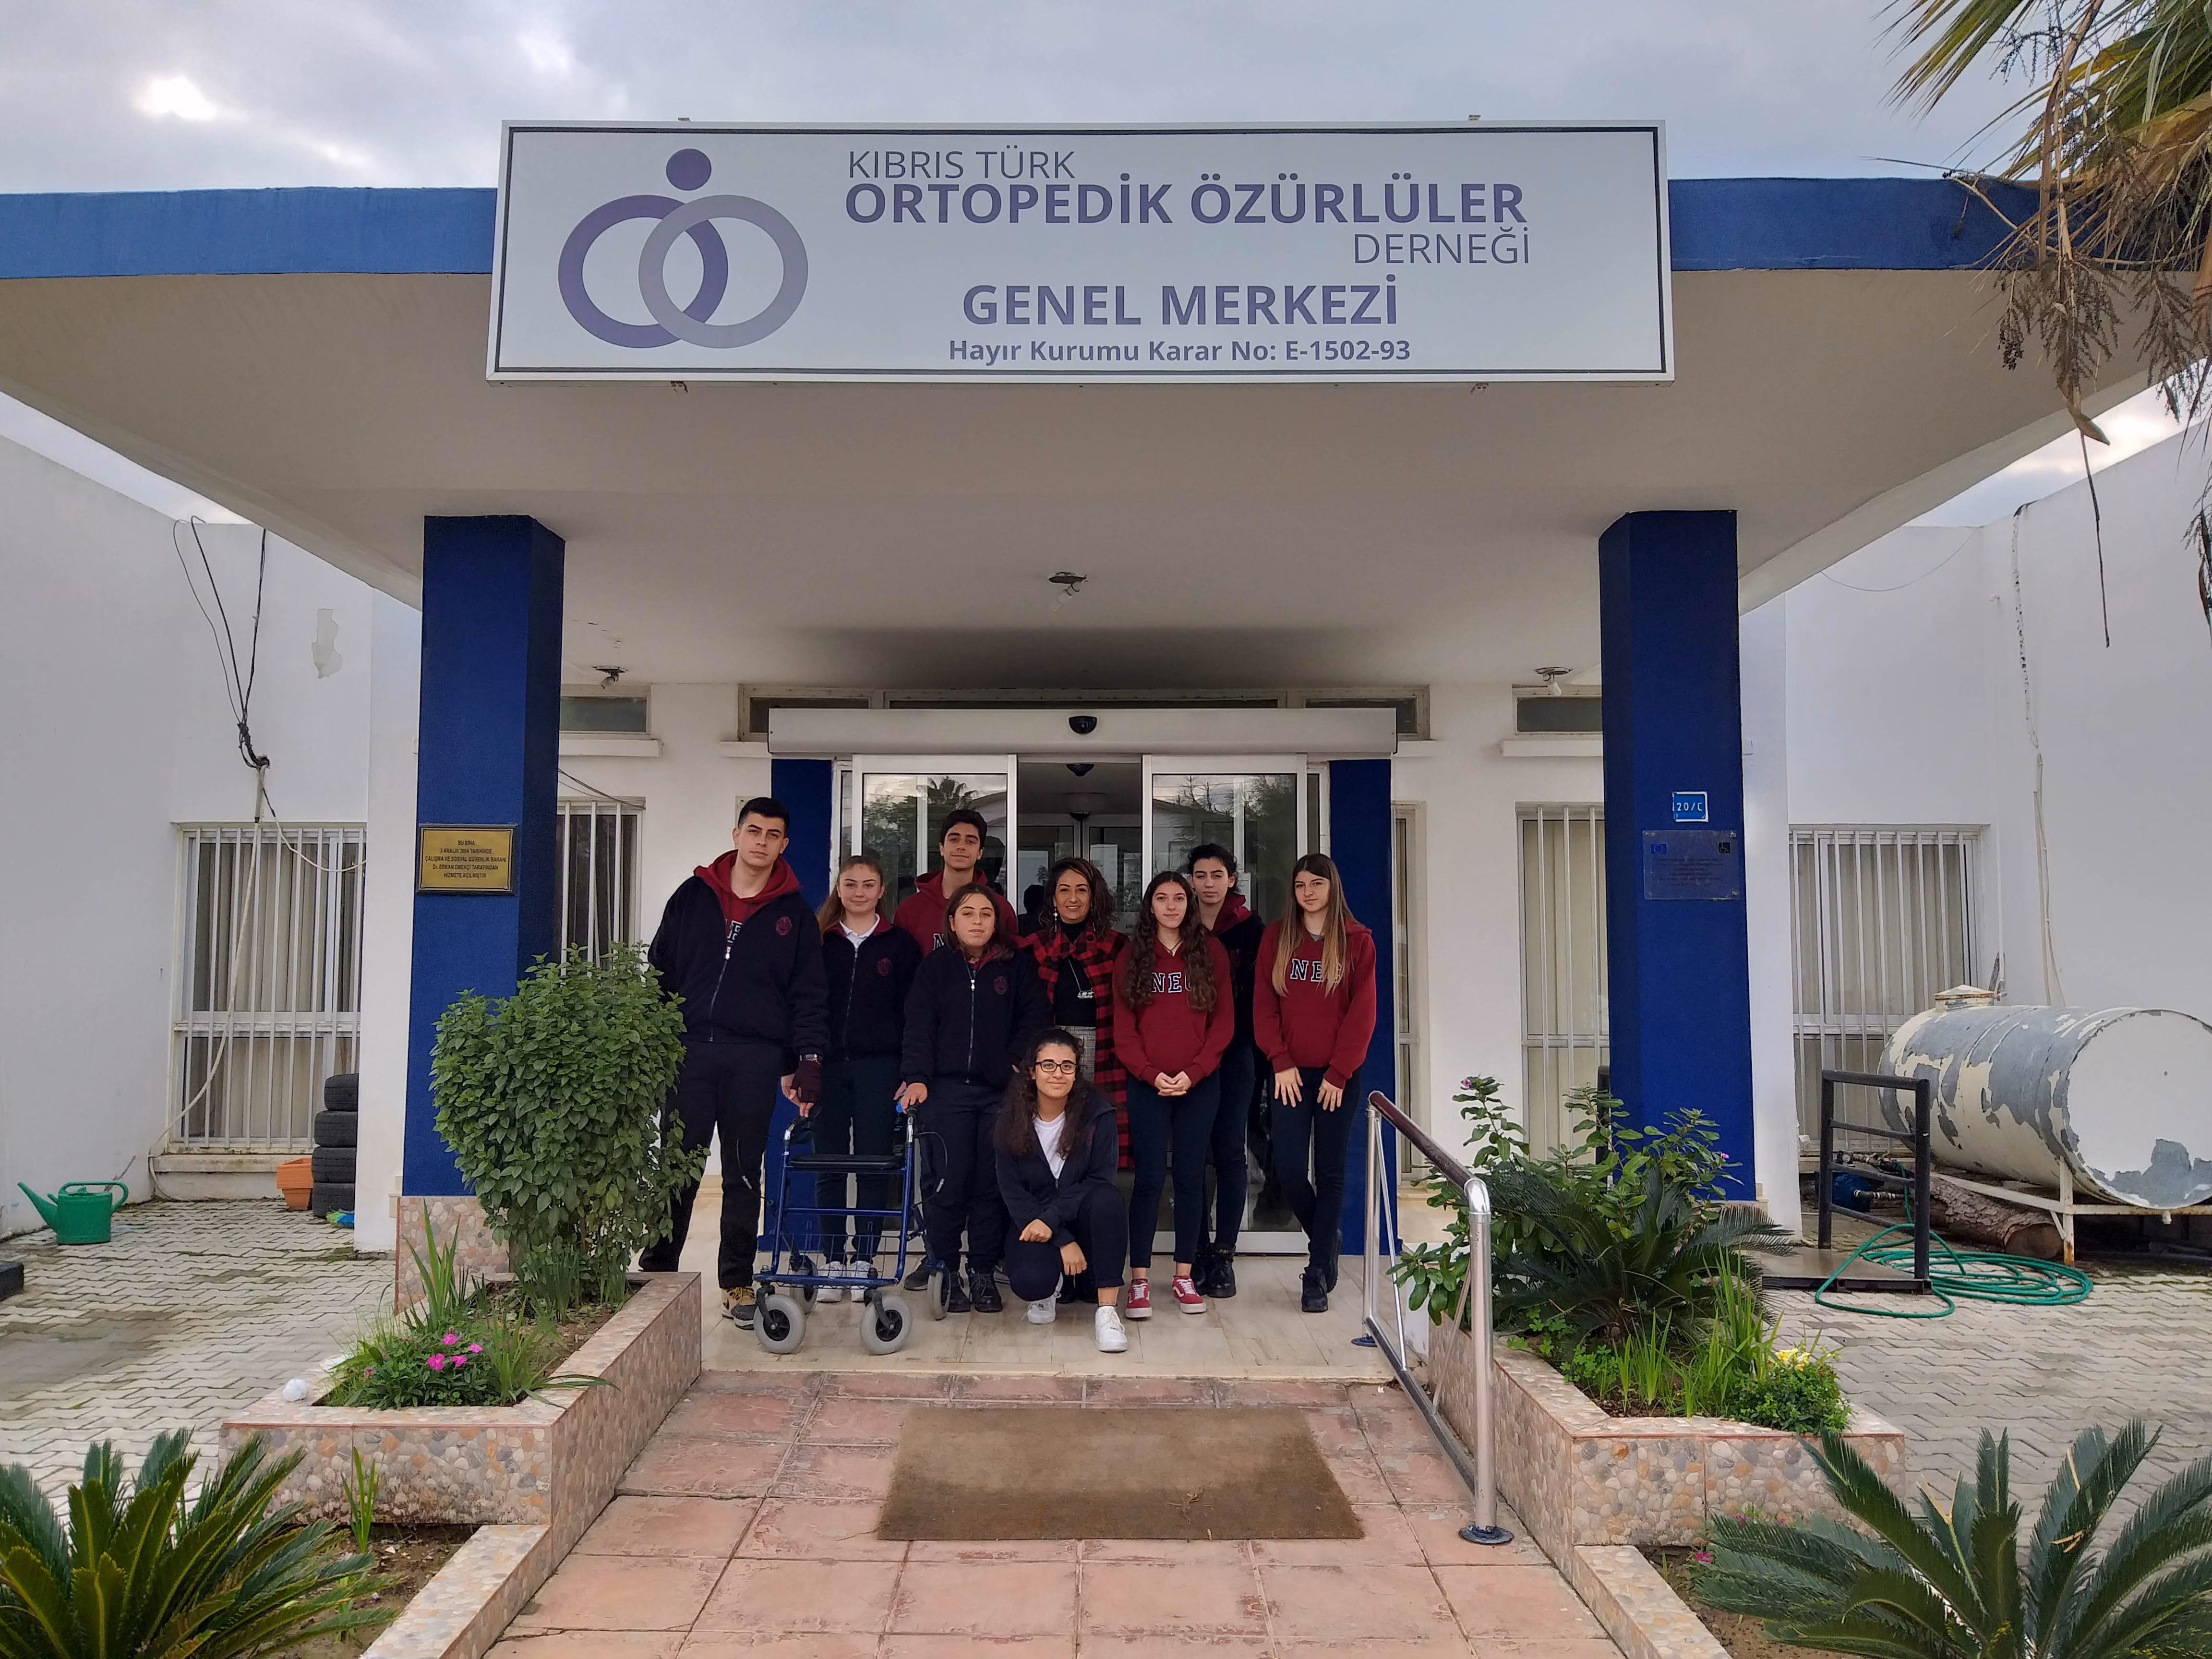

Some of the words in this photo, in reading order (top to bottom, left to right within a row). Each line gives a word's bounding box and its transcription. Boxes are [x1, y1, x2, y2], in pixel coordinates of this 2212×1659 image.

[849, 150, 964, 179] KIBRIS
[975, 144, 1076, 179] TÜRK
[845, 172, 1173, 224] ORTOPEDİK
[1190, 172, 1528, 224] ÖZÜRLÜLER
[1354, 226, 1529, 264] DERNEĞİ
[963, 285, 1142, 325] GENEL
[1162, 274, 1397, 325] MERKEZİ
[950, 340, 1022, 366] Hayır
[1031, 341, 1139, 361] Kurumu
[1149, 341, 1223, 361] Karar
[1232, 340, 1275, 361] No:
[1286, 340, 1411, 361] E-1502-93
[1676, 802, 1703, 812] 20/C
